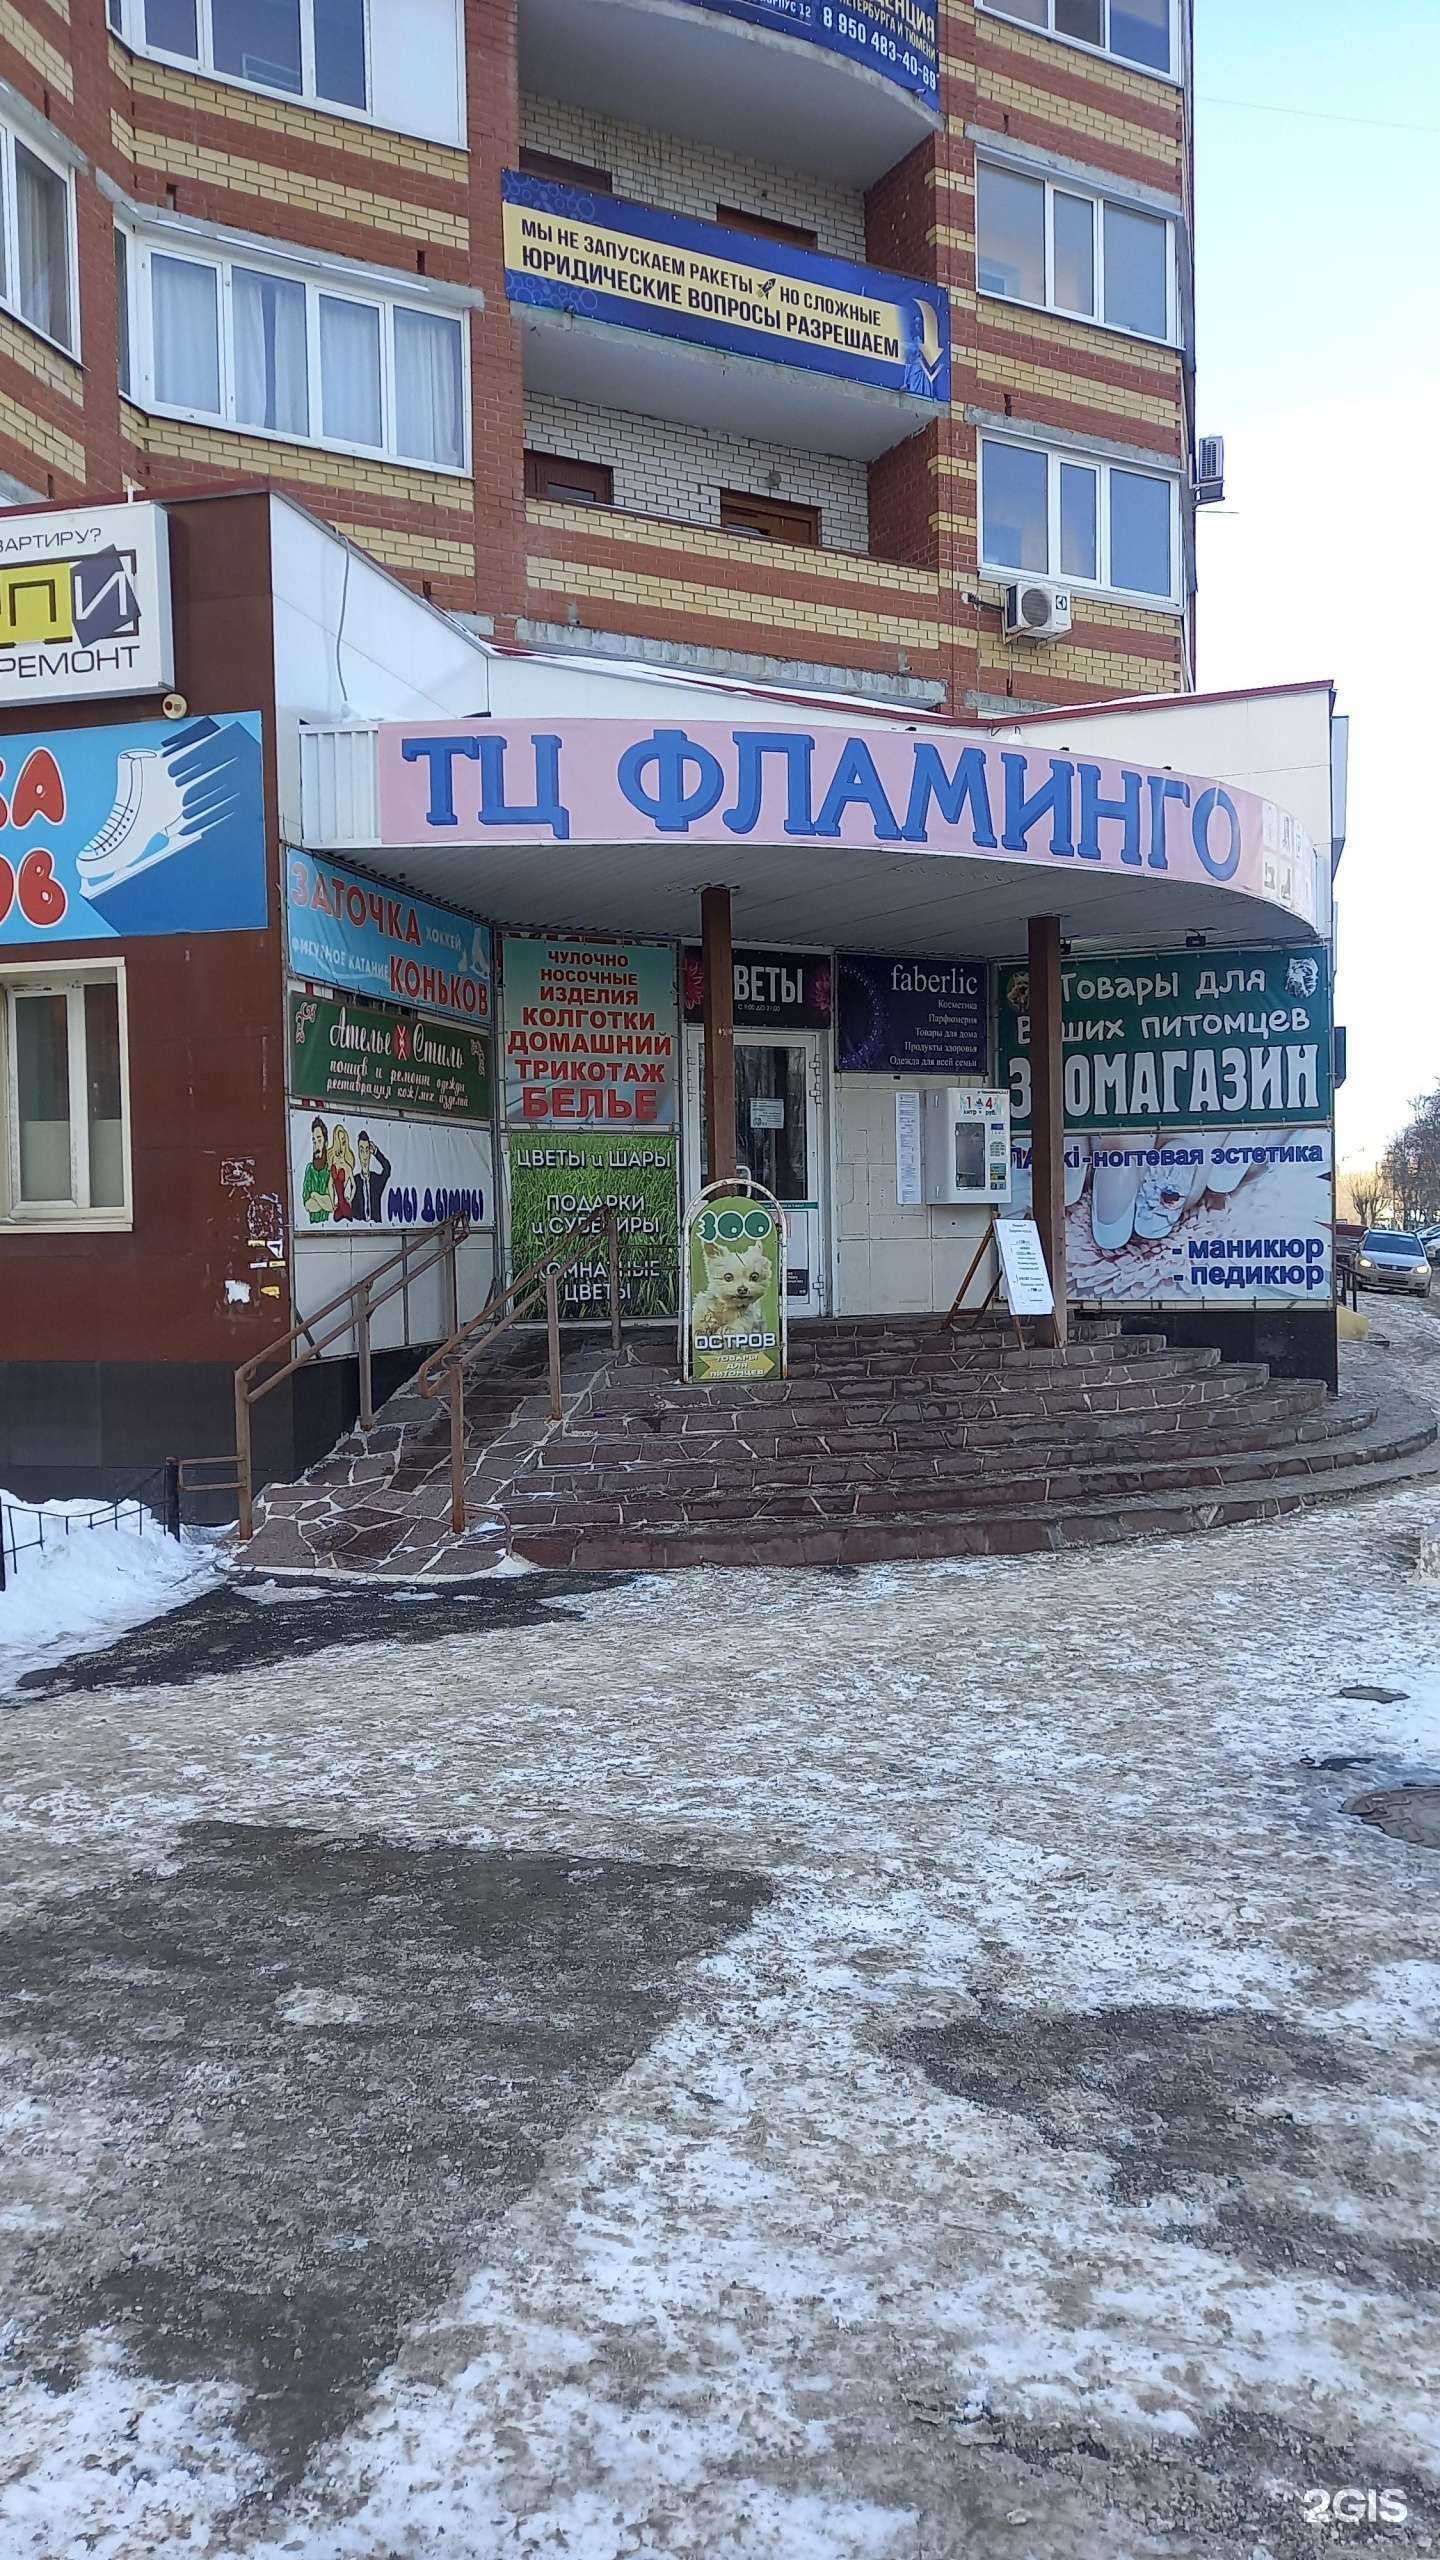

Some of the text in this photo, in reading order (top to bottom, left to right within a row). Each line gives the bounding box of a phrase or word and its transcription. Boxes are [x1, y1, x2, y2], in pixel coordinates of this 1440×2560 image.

[799, 3, 811, 18] 12
[823, 7, 833, 28] 8
[838, 13, 866, 44] 950
[905, 26, 936, 63] ТЮМЕНИ
[521, 219, 882, 327] МЫ НЕ ЗАПУСКАЕМ РАКЕТЫ НО СЛОЖНЫЕ
[521, 245, 900, 359] ЮРИДИЧЕСКИЕ ВОПРОСЫ РАЗРЕШАЕМ
[401, 729, 1241, 881] ТЦ ФЛАМИНГО
[290, 861, 462, 951] ЗАТОЧКА ХОККЕЙ
[349, 954, 389, 977] КАТАНИЕ
[548, 950, 629, 968] ЧУЛОЧНО
[389, 954, 490, 1018] КОНЬКОВ
[540, 968, 639, 986] НОСОЧНЫЕ
[733, 964, 803, 1004] ВЕТЫ
[890, 964, 978, 995] faberlic
[1060, 969, 1267, 1007] Товары для
[540, 986, 639, 1006] ИЗДЕЛИЯ
[938, 999, 978, 1010] Косметика
[523, 1007, 655, 1031] КОЛГОТКИ
[928, 1013, 978, 1026] Парфюмерия
[1017, 1007, 1311, 1046] Вших питомцев
[329, 1006, 465, 1069] Ателье Стиль
[507, 1031, 671, 1056] ДОМАШНИЙ
[915, 1027, 978, 1039] Товары для дома
[904, 1041, 943, 1053] Продукты
[514, 1059, 665, 1083] ТРИКОТАЖ
[889, 1055, 977, 1067] Одежда для всей семьи
[326, 1078, 392, 1100] реставрация
[375, 1066, 383, 1079] и
[390, 1068, 431, 1087] ремонт
[436, 1076, 466, 1095] одежды
[1008, 1044, 1320, 1119] ЗОМАГАЗИН
[522, 1086, 657, 1120] БЕЛЬЕ
[985, 1096, 993, 1110] 4
[518, 1150, 586, 1168] ЦВЕТЫ
[609, 1150, 671, 1168] ШАРЫ
[1210, 1143, 1324, 1167] эстетика
[387, 1186, 418, 1223] МЫ
[547, 1194, 645, 1213] ПОДАРКИ
[696, 1210, 773, 1244] ЗОО
[1188, 1237, 1325, 1264] маникюр
[1191, 1263, 1325, 1291] педикюр
[694, 1332, 776, 1351] ОСТРОВ
[709, 1368, 765, 1378] ПИТОМЦЕВ
